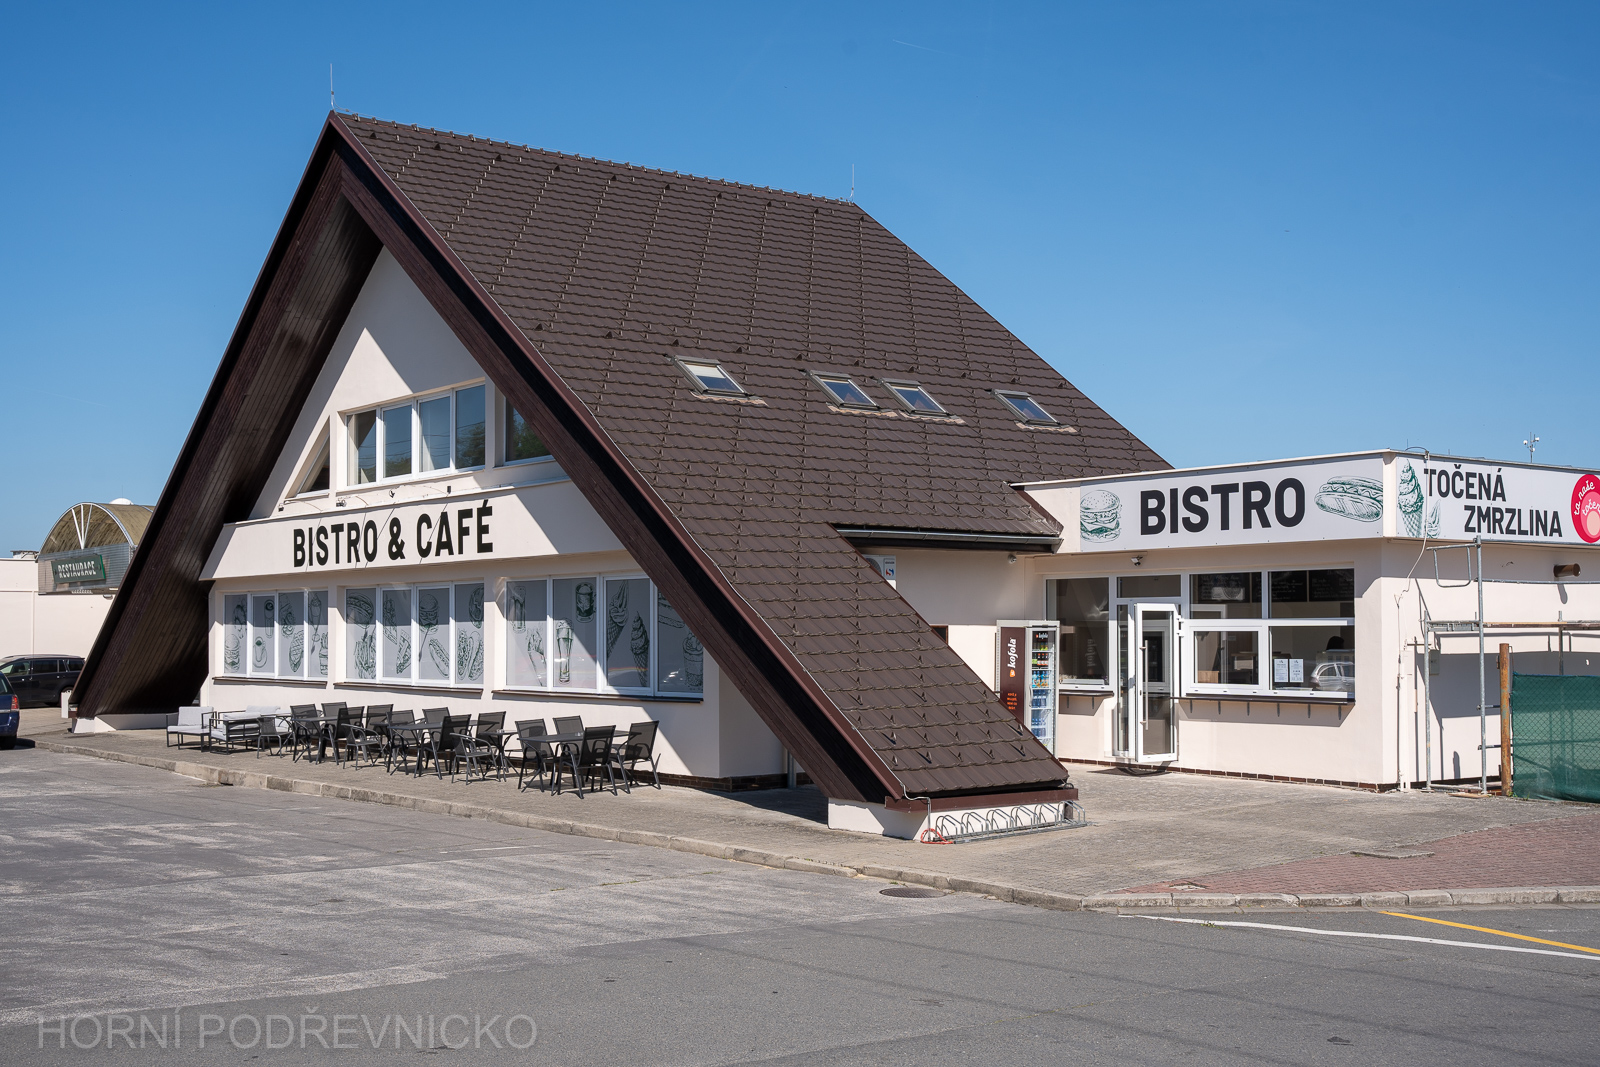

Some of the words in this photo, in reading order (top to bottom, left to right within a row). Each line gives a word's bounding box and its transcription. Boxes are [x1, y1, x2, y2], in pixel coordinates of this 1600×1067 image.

[1424, 464, 1506, 502] TOČENÁ
[1578, 480, 1595, 500] naše
[1140, 477, 1305, 536] BISTRO
[1464, 505, 1563, 537] ZMRZLINA
[293, 519, 378, 568] BISTRO
[388, 516, 406, 561] &
[416, 499, 493, 558] CAFÉ
[1007, 637, 1018, 669] kofola
